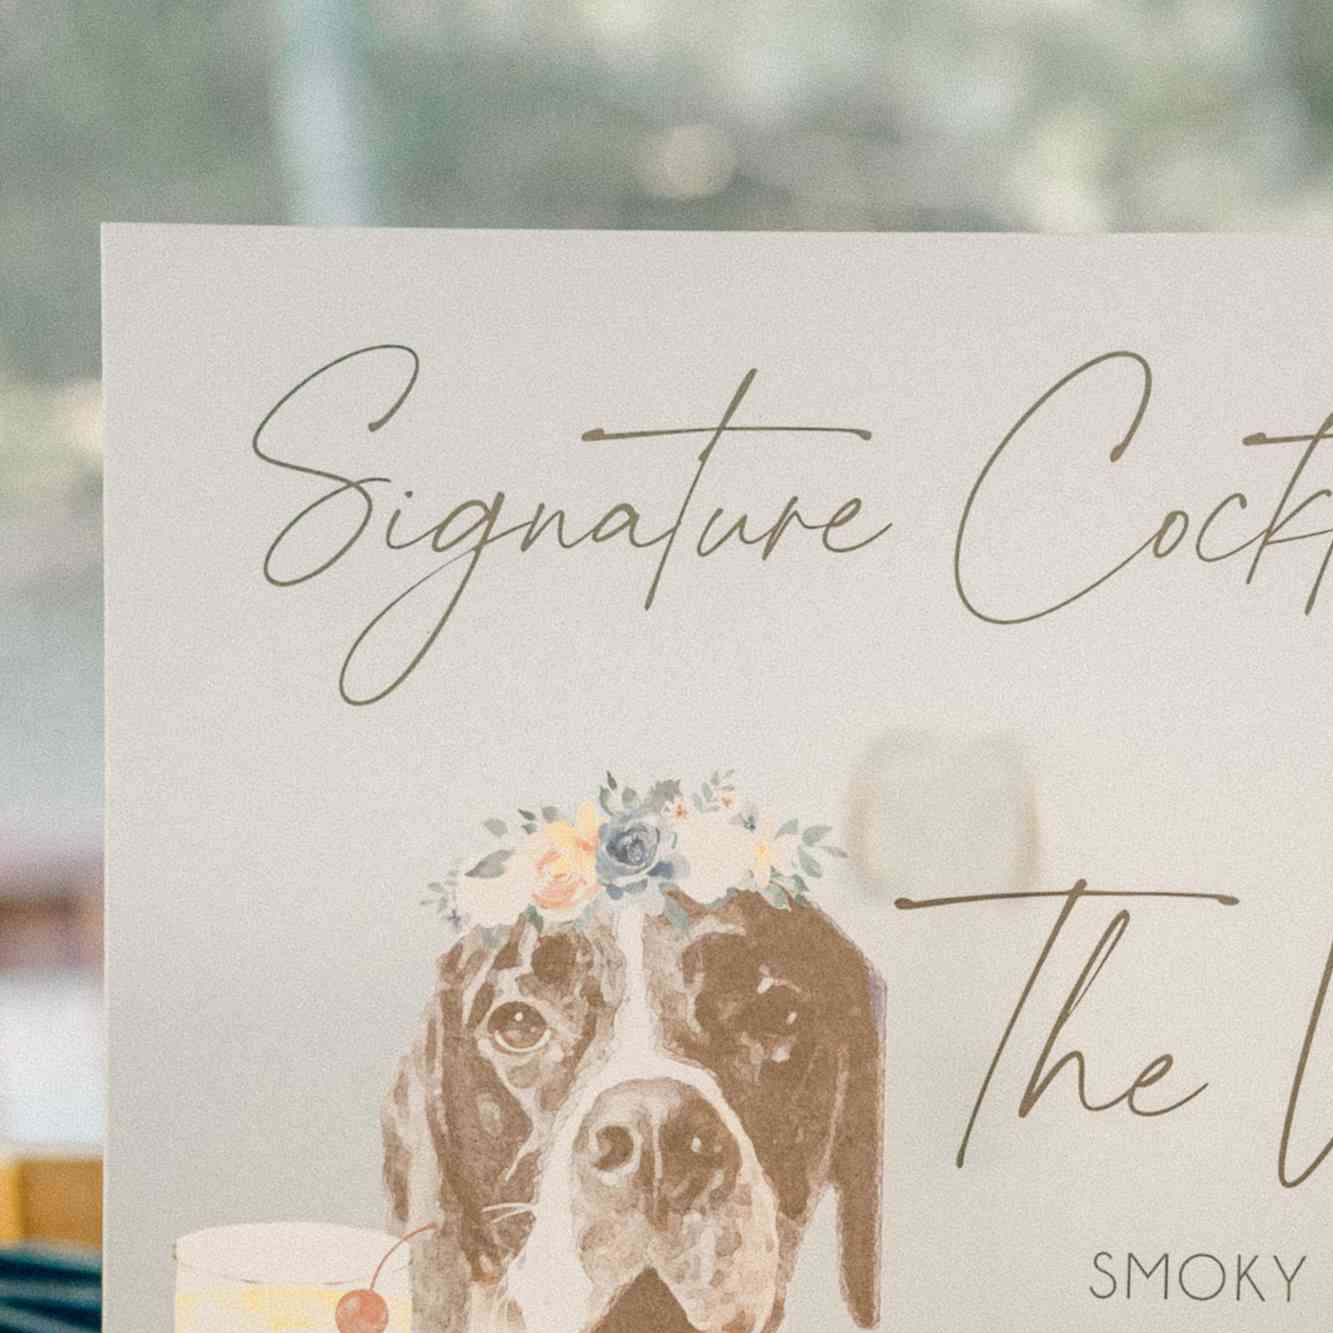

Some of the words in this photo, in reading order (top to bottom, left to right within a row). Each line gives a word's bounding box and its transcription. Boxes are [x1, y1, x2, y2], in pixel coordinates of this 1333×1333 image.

[250, 342, 894, 708] Signature
[892, 877, 1242, 1170] The
[1088, 1250, 1308, 1304] SMOKY
